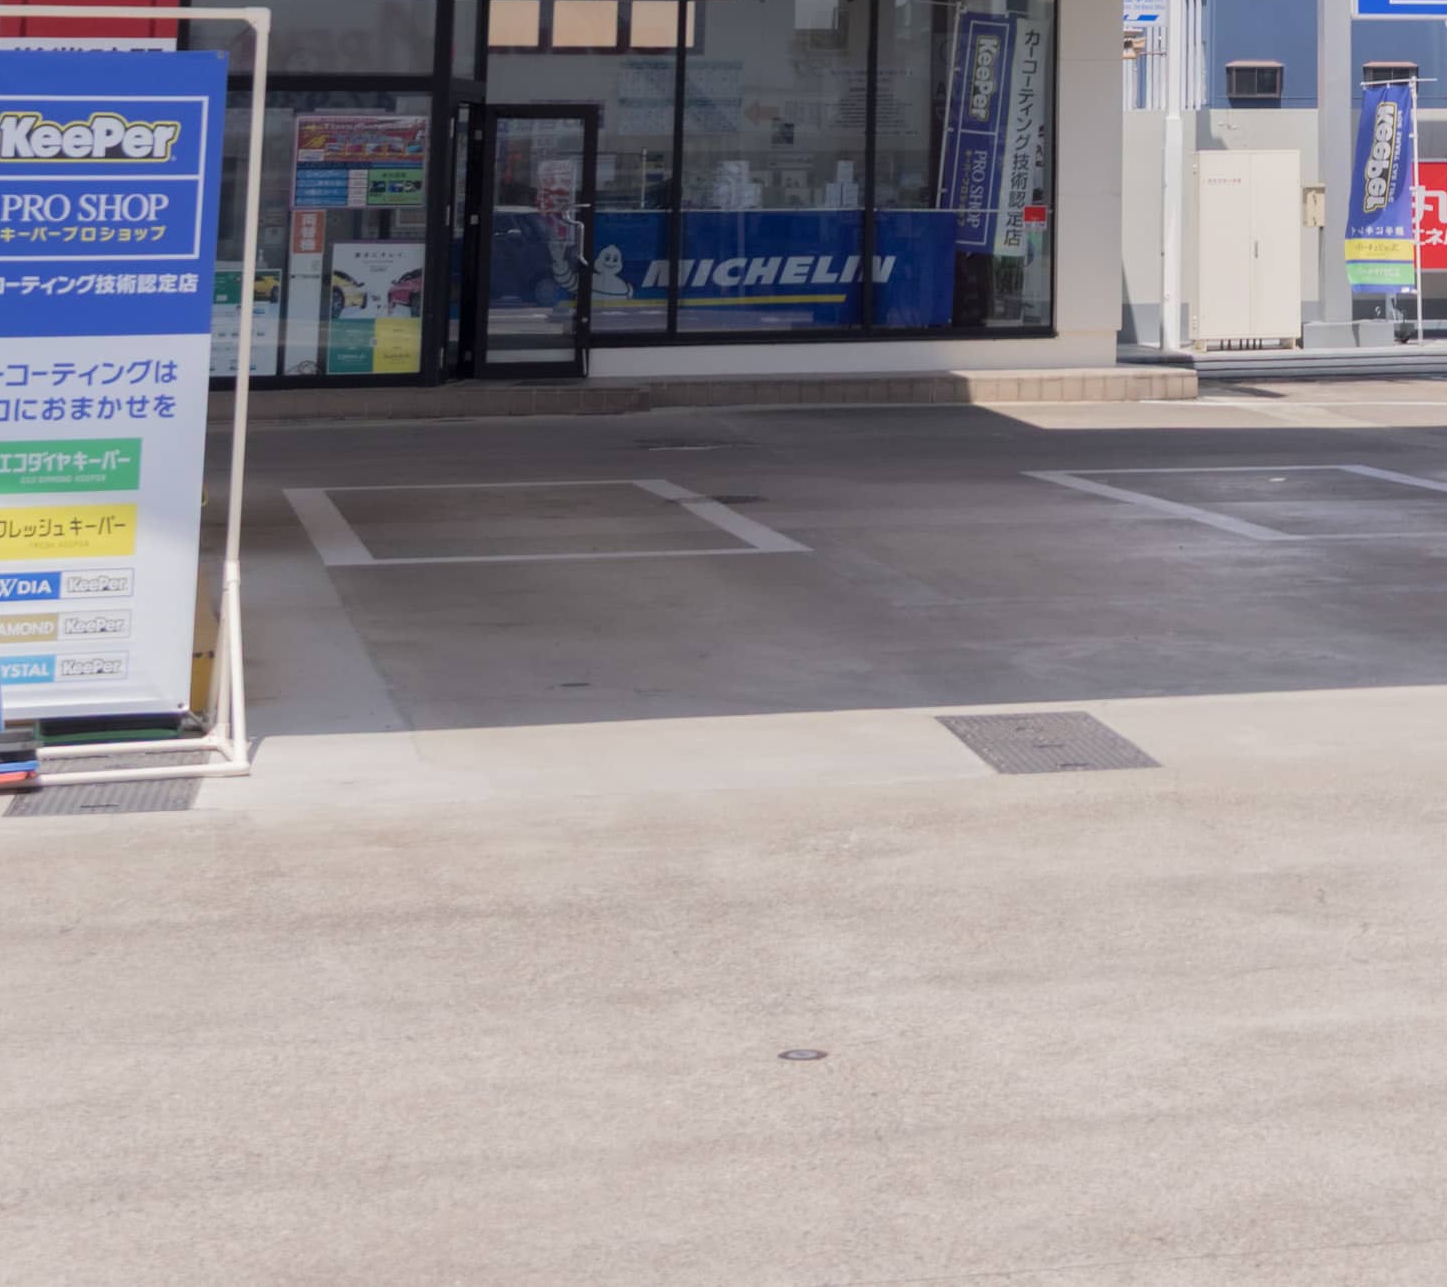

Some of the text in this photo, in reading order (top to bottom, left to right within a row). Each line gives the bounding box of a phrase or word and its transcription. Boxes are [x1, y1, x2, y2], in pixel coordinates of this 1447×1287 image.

[969, 34, 1001, 122] KeePer
[0, 192, 170, 223] PRO SHOP
